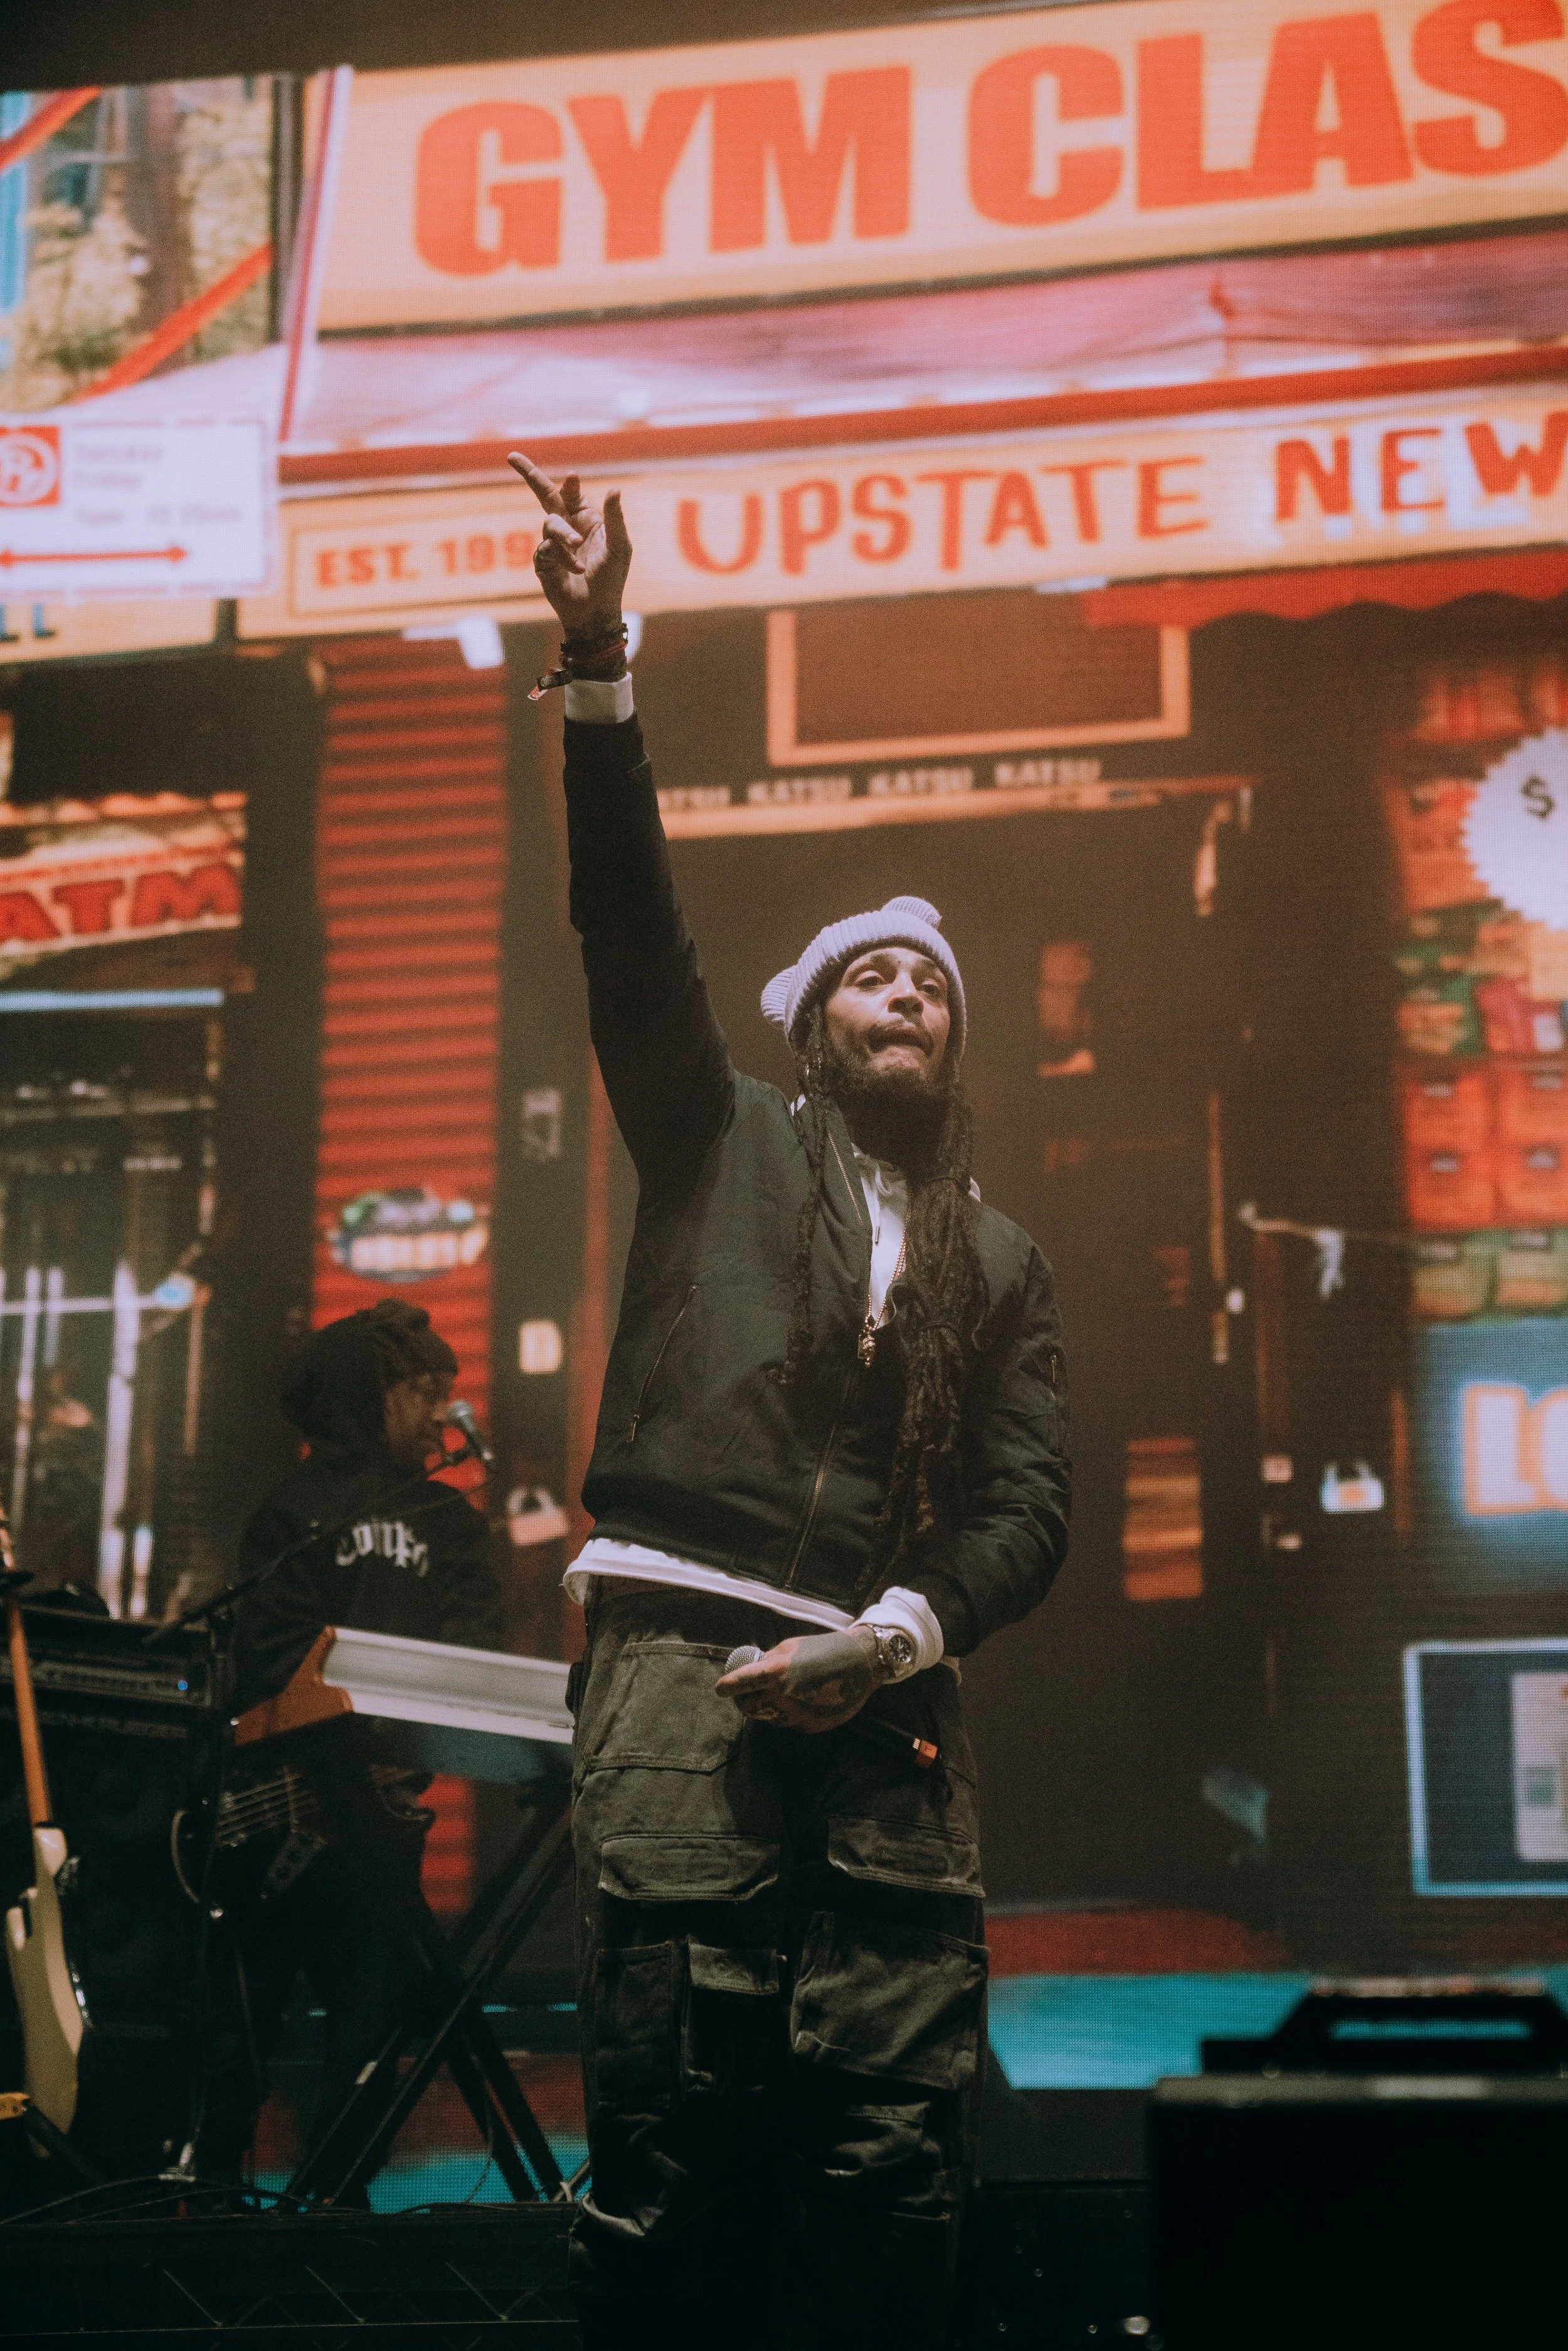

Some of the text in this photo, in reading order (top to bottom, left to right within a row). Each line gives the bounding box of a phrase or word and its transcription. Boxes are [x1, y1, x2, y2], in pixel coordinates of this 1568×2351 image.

[414, 0, 1568, 278] GYM CLAS
[676, 410, 1568, 576] UPSTATE NEW
[317, 531, 536, 590] EST. 199
[0, 863, 241, 943] ATM
